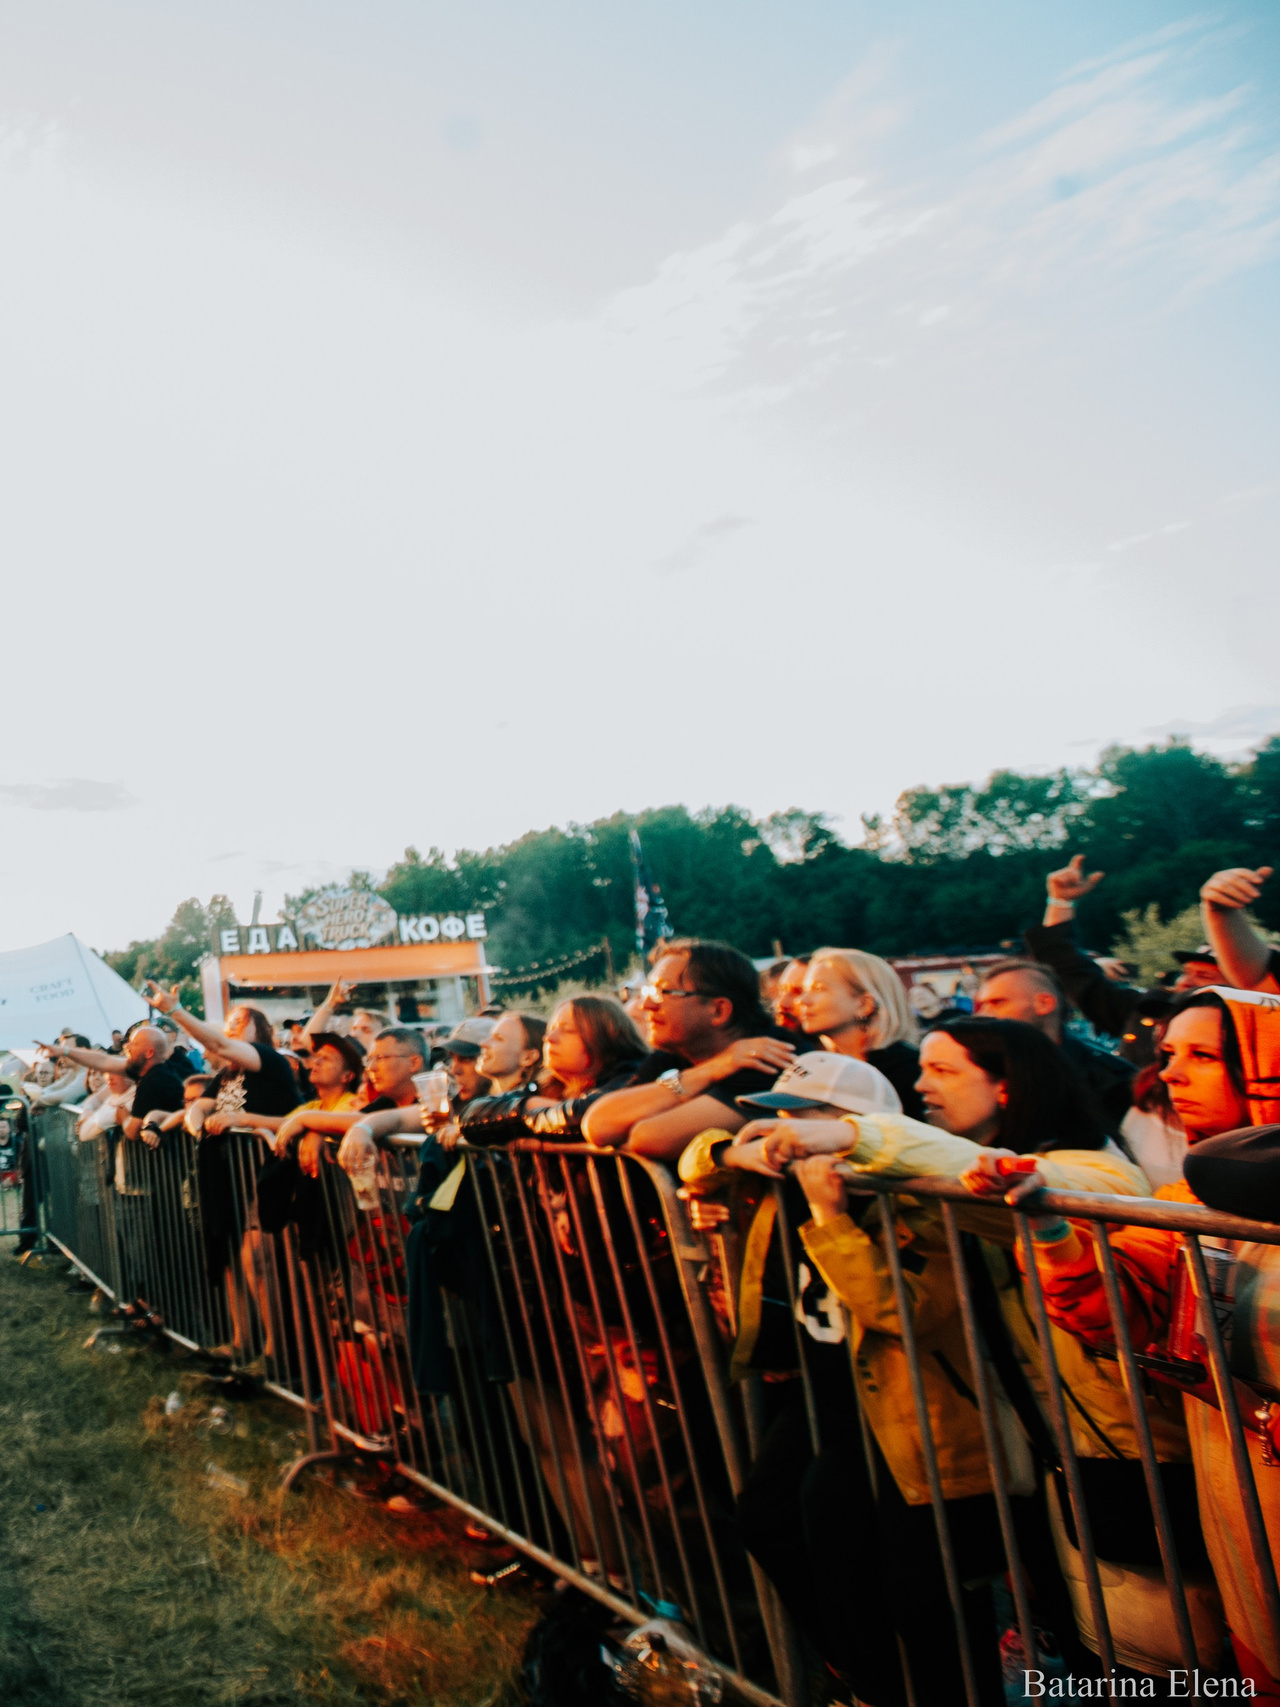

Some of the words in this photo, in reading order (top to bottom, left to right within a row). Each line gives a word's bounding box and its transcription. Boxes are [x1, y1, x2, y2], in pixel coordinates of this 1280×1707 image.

[317, 893, 369, 917] SUPER
[326, 909, 366, 926] HERO
[399, 914, 487, 941] КОФЕ
[221, 926, 298, 954] ЕДА
[322, 922, 371, 942] TRUCK
